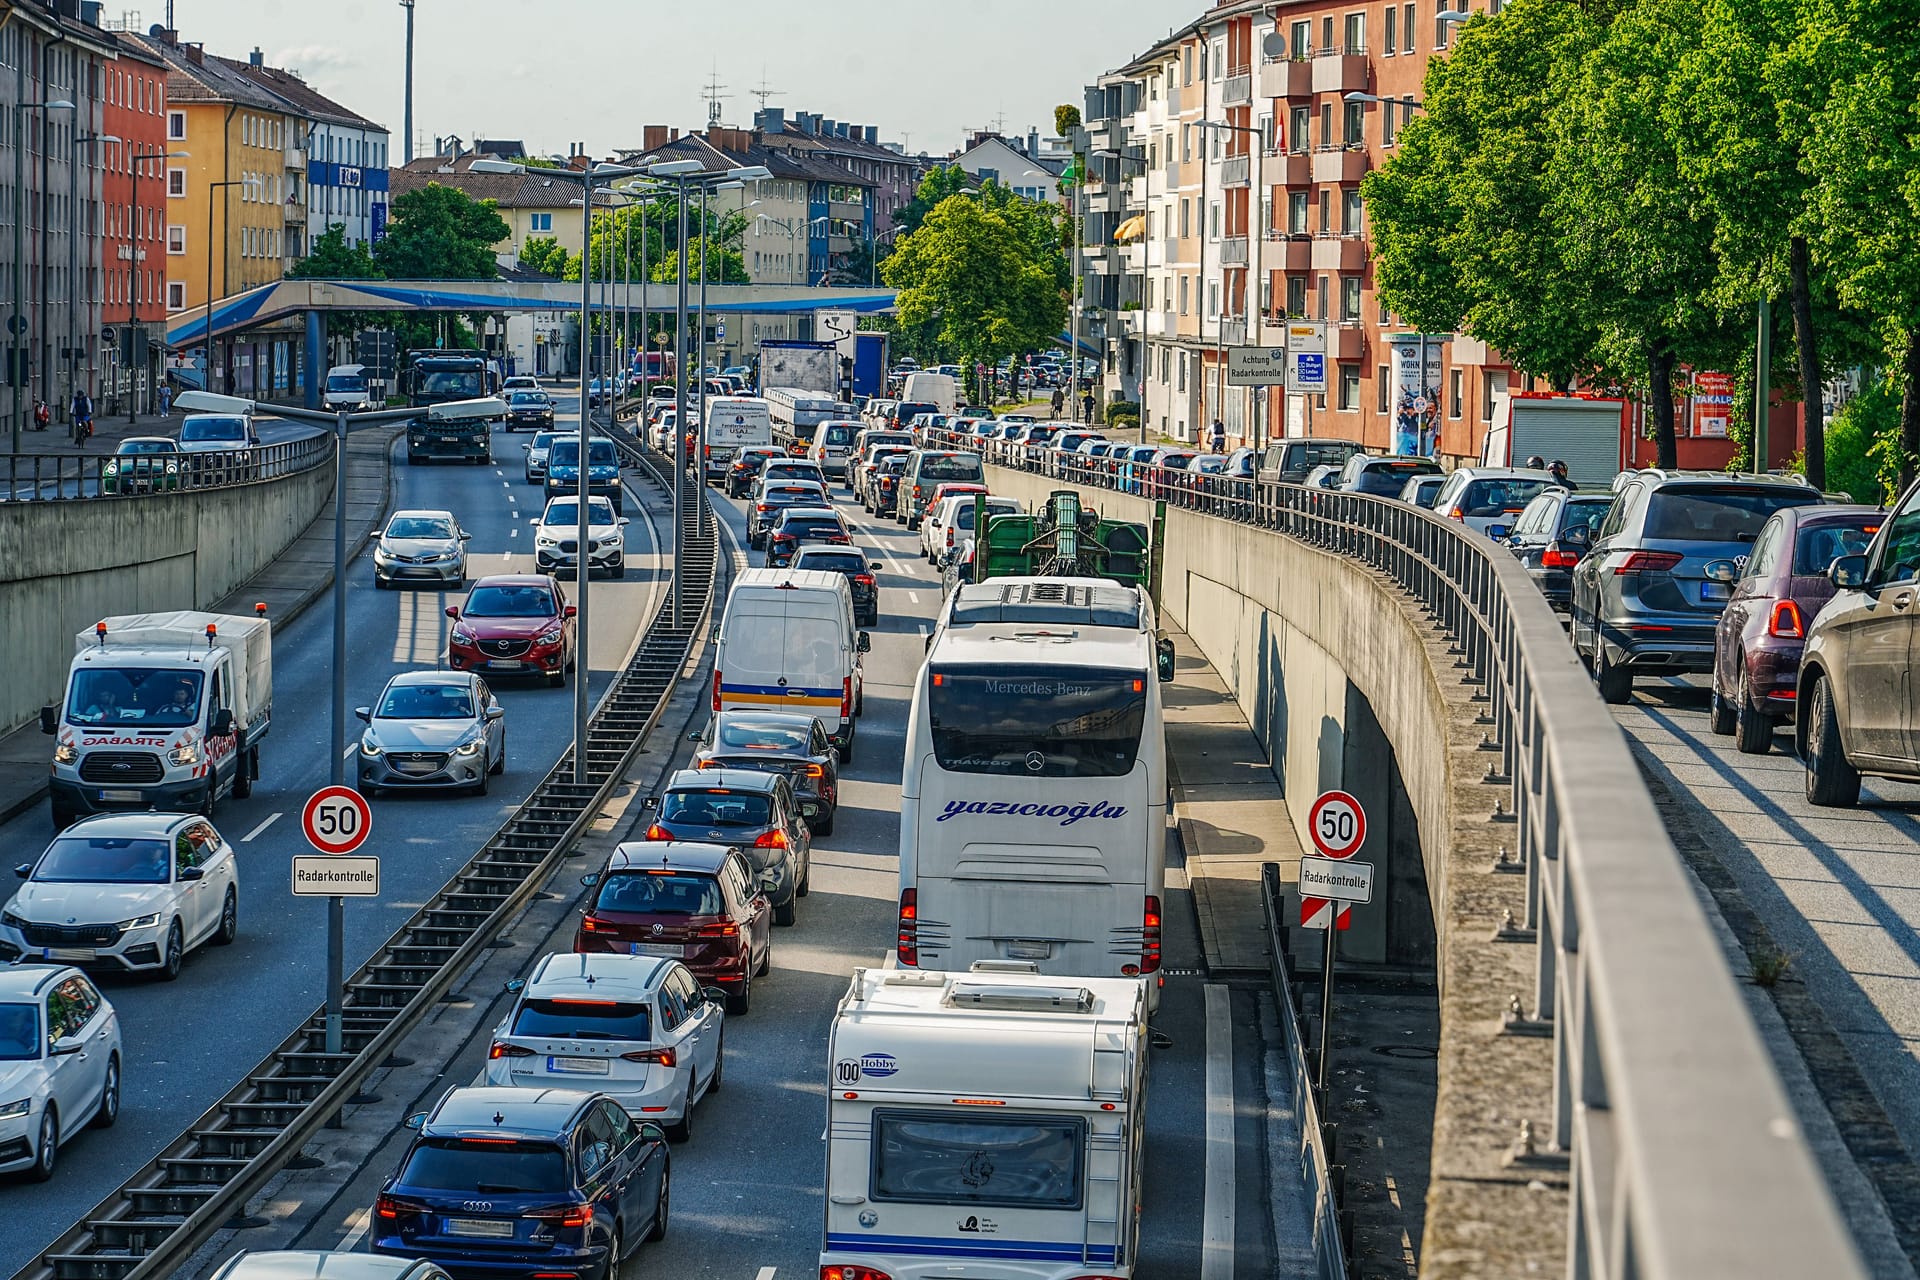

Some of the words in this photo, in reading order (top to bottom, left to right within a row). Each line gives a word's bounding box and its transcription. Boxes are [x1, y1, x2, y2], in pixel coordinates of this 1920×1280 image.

[1242, 355, 1270, 365] Achtung
[1231, 369, 1281, 377] Radarkontrolle
[985, 679, 1091, 696] Mercedes-Benz
[943, 759, 1012, 767] TRAVEGO
[320, 805, 356, 835] 50
[1321, 809, 1354, 842] 50
[297, 869, 374, 882] Radarkontrolle
[1304, 870, 1368, 889] Radarkontrolle
[837, 1063, 859, 1081] 100
[861, 1059, 896, 1073] Hobby
